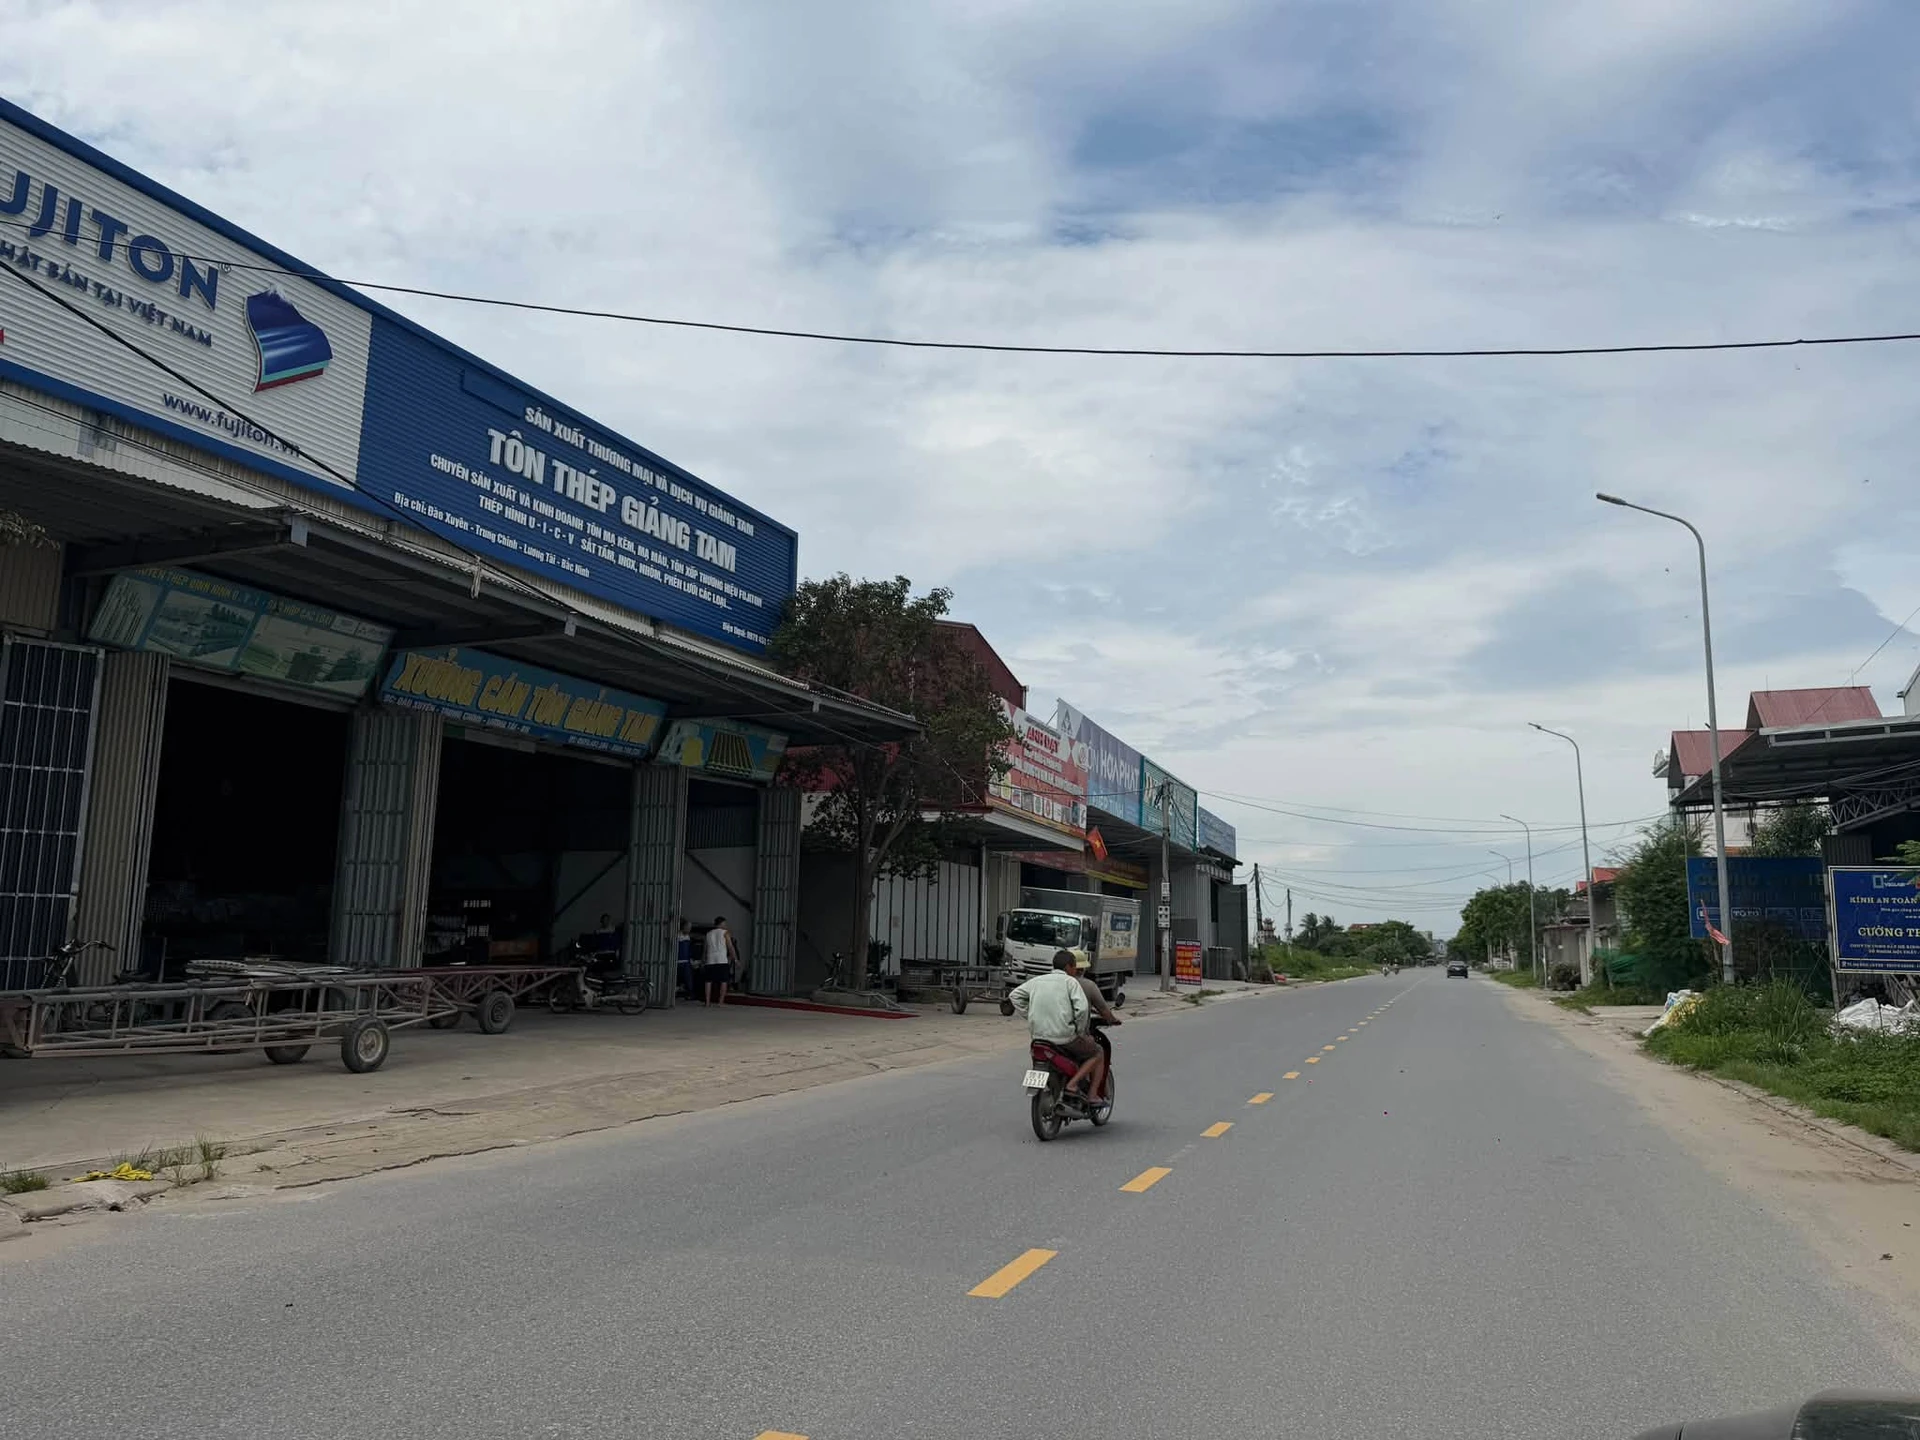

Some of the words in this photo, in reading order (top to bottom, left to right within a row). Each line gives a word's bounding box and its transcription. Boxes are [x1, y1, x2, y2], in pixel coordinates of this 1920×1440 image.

[127, 297, 169, 325] VIỆT
[172, 316, 211, 347] NAM
[163, 393, 300, 458] www.fujiton.vn
[430, 454, 469, 481] CHUYÊN
[470, 471, 491, 491] SẢN
[493, 482, 518, 503] XUẤT
[518, 491, 531, 509] VÀ
[532, 498, 554, 518] KINH
[554, 509, 583, 531] DOANH
[586, 521, 601, 539] TÔN
[602, 530, 616, 545] MẠ
[637, 544, 650, 561] MẠ
[670, 559, 685, 575] TÔN
[487, 428, 546, 484] TÔN
[552, 461, 616, 514] THÉP
[620, 495, 691, 551] GIẢNG
[695, 529, 736, 573] TAM
[525, 406, 552, 432] SẢN
[554, 422, 585, 449] XUẤT
[587, 439, 630, 472] THƯƠNG
[632, 463, 654, 486] MẠI
[655, 475, 668, 492] VÀ
[695, 496, 708, 515] VỤ
[708, 504, 736, 528] GIẢNG
[736, 518, 755, 537] TAM
[394, 491, 408, 508] Địa
[427, 505, 443, 520] Đào
[444, 512, 469, 532] Xuyên
[475, 524, 495, 543] Trung
[523, 543, 544, 562] Lương
[545, 551, 556, 565] Tài
[574, 564, 590, 578] Ninh
[479, 494, 503, 515] THÉP
[504, 506, 527, 527] HÌNH
[529, 517, 536, 529] U
[542, 521, 547, 534] I
[554, 527, 561, 539] C
[568, 532, 575, 545] V
[580, 537, 596, 554] SẮT
[392, 648, 483, 706] XƯỞNG
[478, 672, 532, 718] CÁN
[524, 682, 571, 728] TÔN
[563, 690, 624, 738] GIẢNG
[1849, 896, 1875, 904] KÍNH
[1891, 896, 1918, 904] TOÀN
